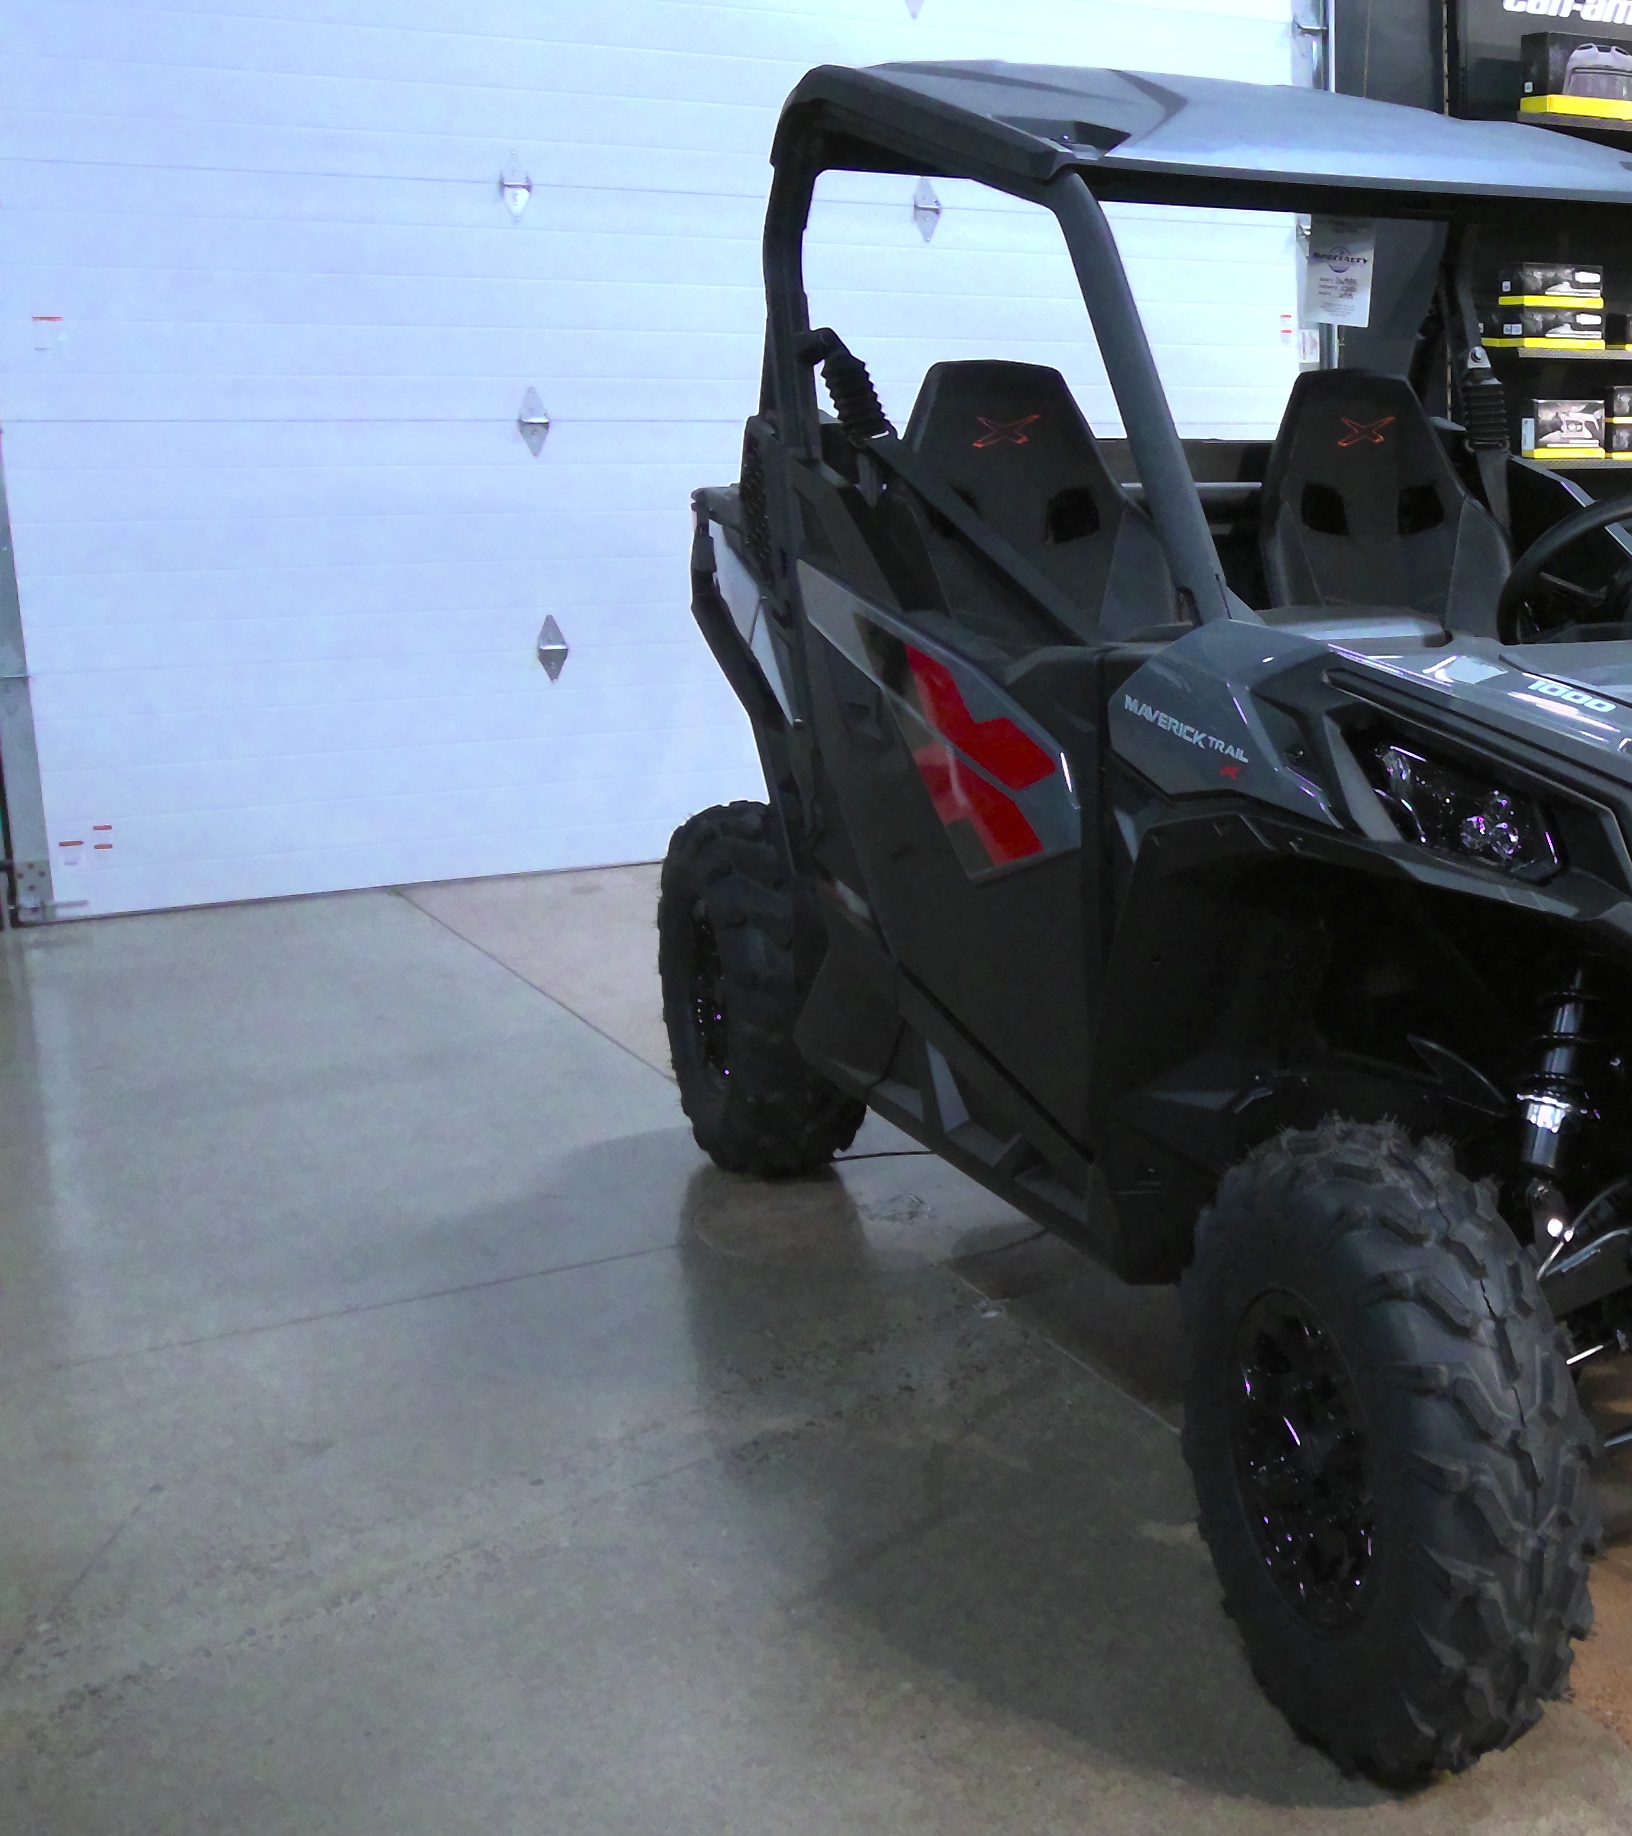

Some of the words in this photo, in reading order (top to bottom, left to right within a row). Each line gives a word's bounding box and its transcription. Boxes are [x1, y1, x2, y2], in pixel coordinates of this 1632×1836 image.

[1527, 679, 1617, 713] 1000
[1124, 694, 1207, 750] MAVERICK
[1207, 735, 1249, 764] TRAIL
